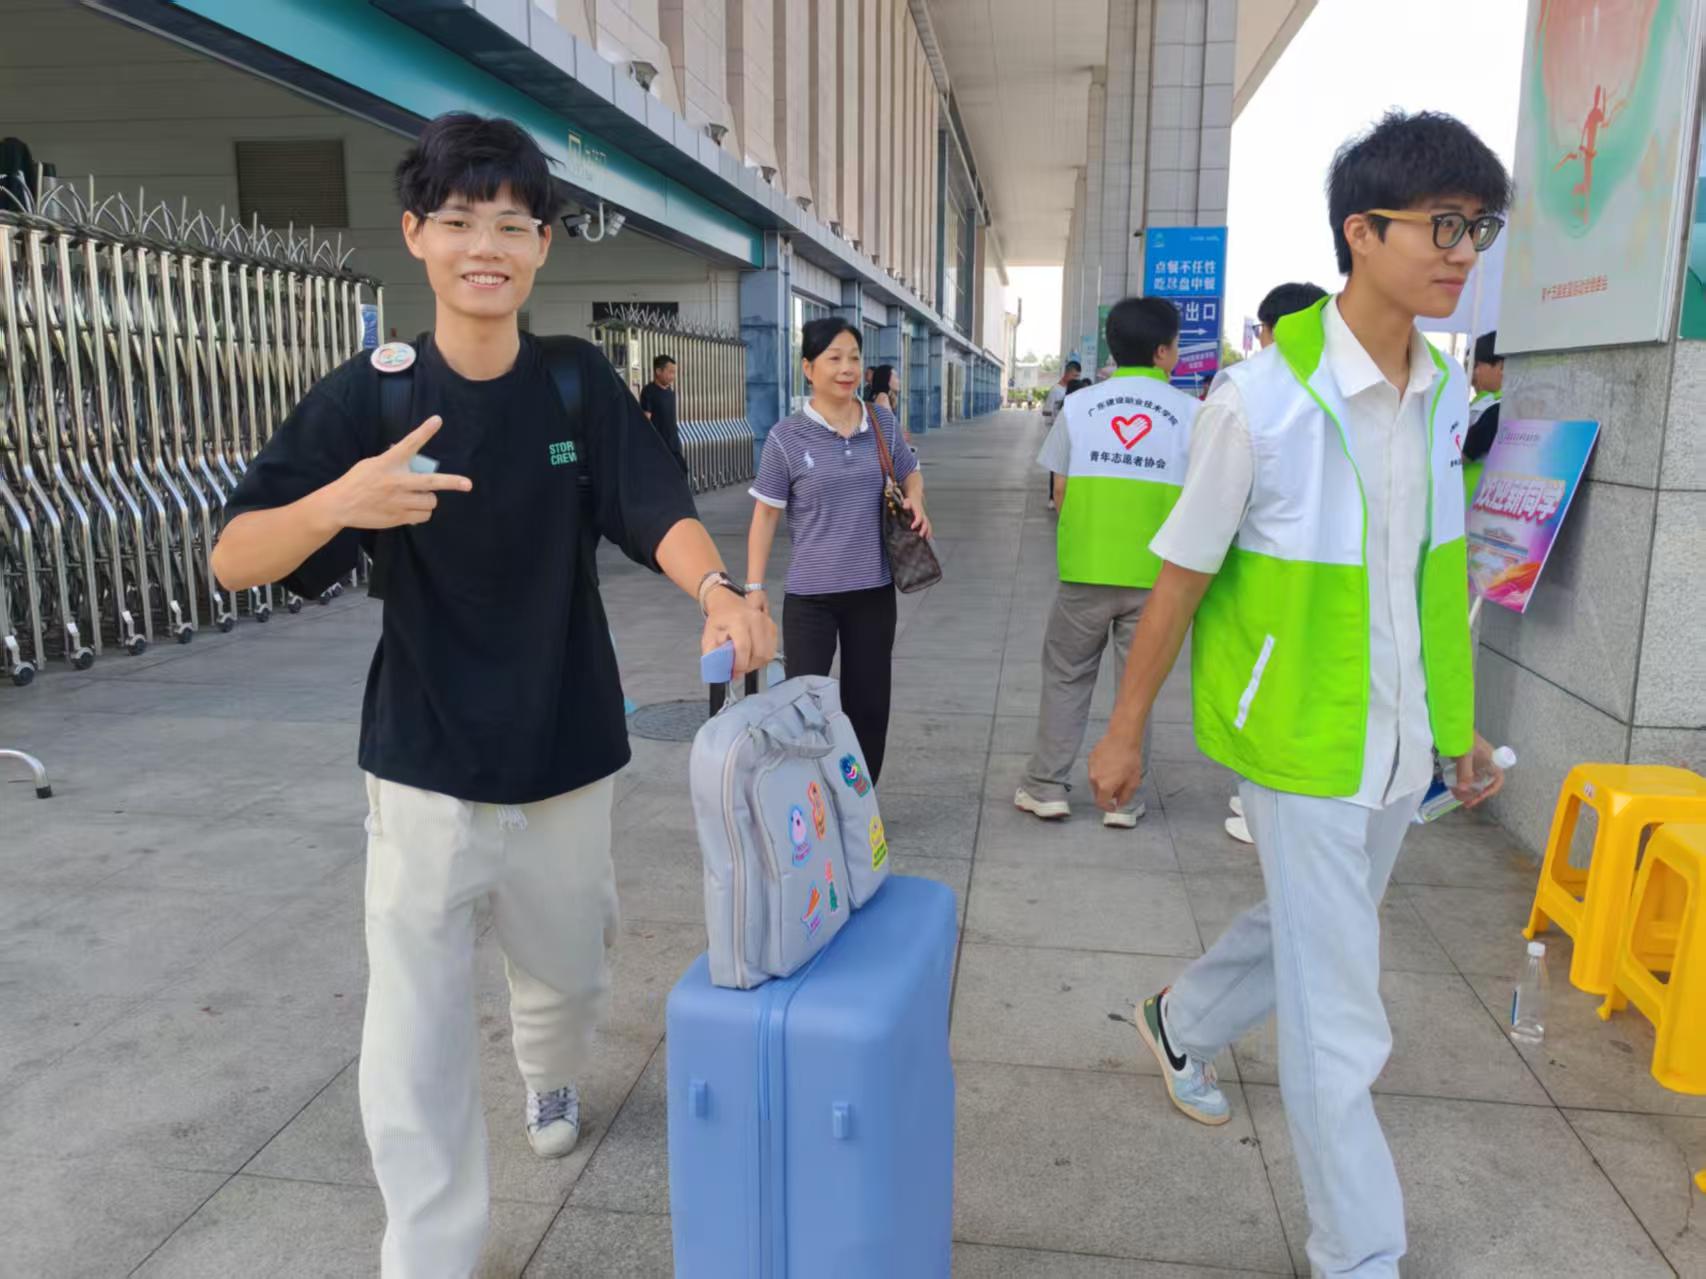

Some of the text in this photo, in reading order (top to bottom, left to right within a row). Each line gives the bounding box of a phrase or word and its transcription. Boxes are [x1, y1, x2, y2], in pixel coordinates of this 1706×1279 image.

[1155, 260, 1216, 275] 点餐不任性
[1090, 451, 1167, 469] 青年志愿者协会
